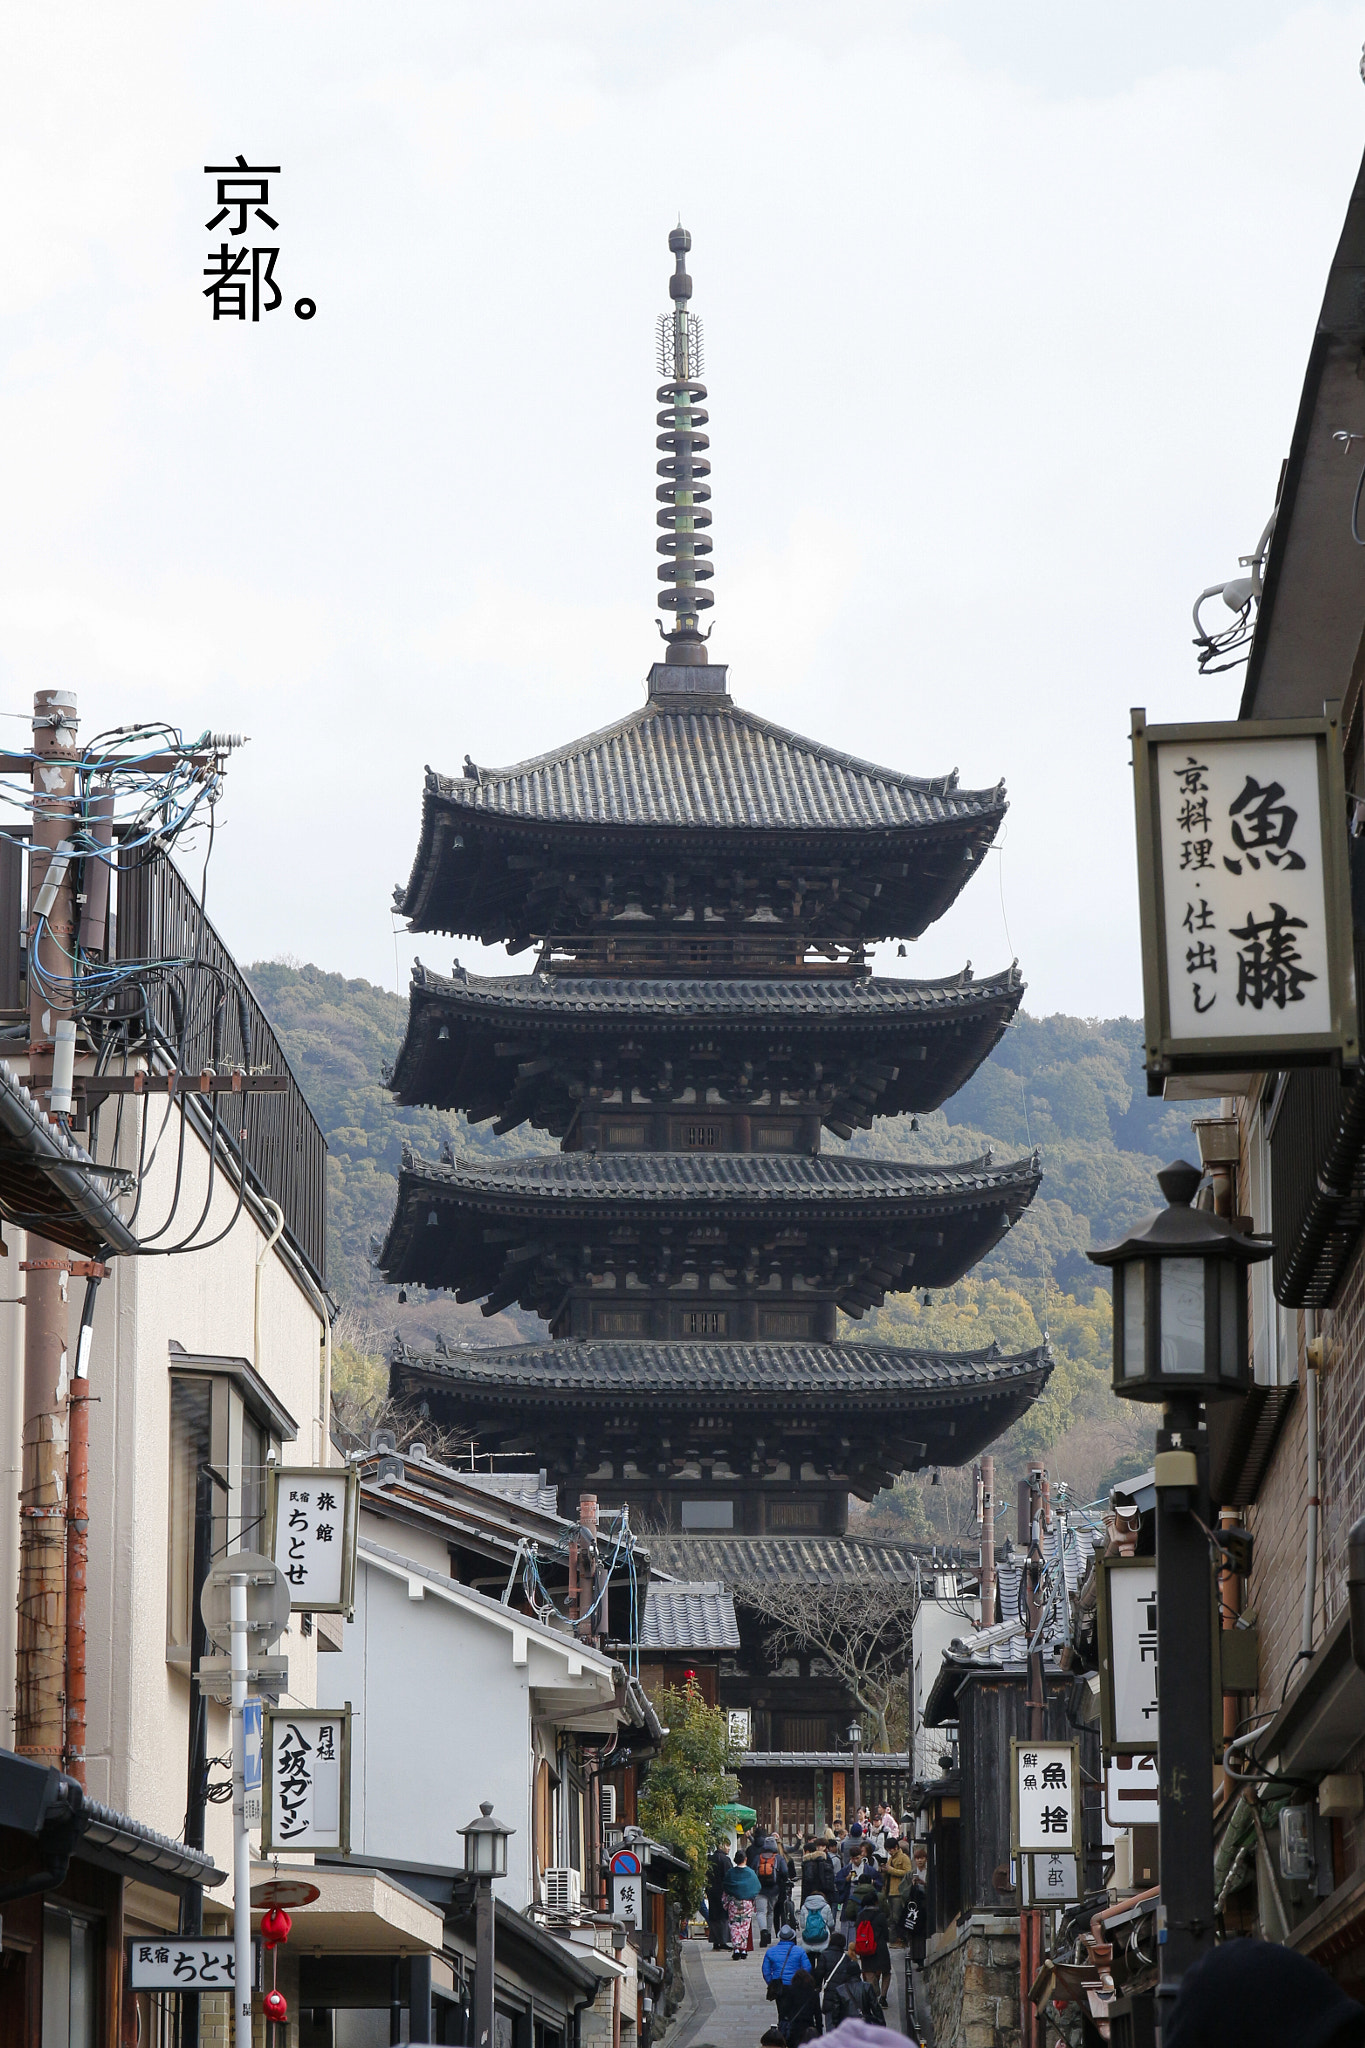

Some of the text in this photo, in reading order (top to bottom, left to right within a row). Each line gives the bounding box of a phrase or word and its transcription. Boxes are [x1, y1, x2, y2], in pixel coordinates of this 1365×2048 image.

[1223, 774, 1318, 1010] 魚藤
[289, 1491, 310, 1503] 民宿
[315, 1491, 338, 1543] 旅館
[284, 1508, 309, 1585] ちとせ
[316, 1725, 336, 1761] 月極
[1022, 1753, 1039, 1791] 鮮魚
[277, 1723, 313, 1840] 八坂ガレージ
[1040, 1762, 1069, 1833] 魚捨
